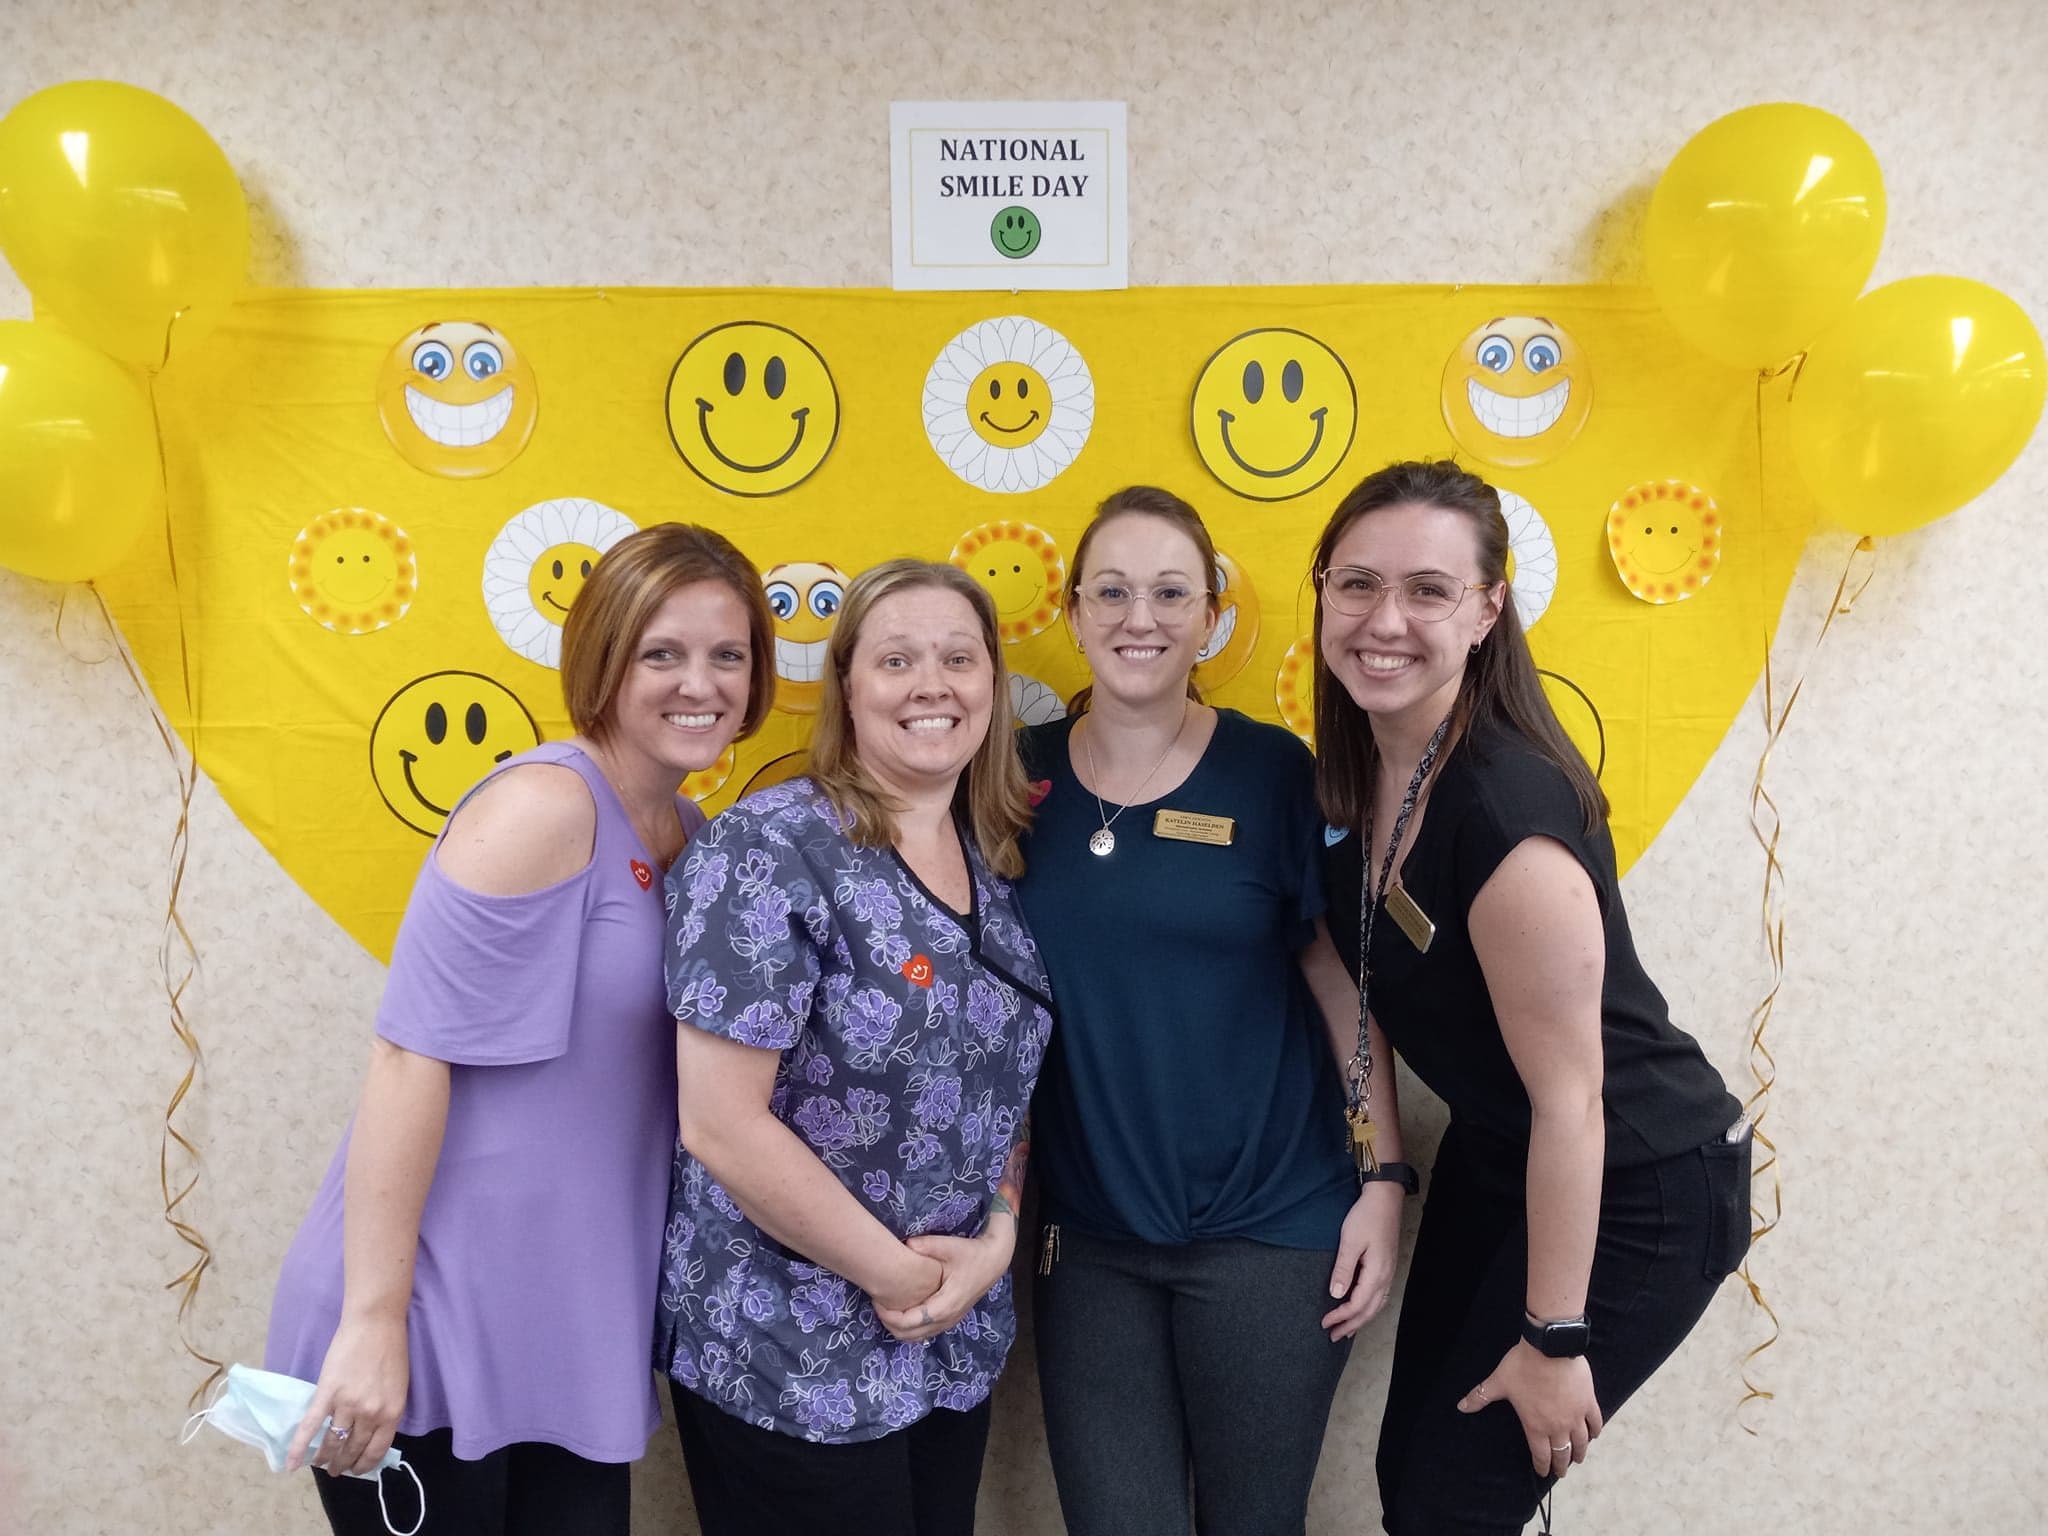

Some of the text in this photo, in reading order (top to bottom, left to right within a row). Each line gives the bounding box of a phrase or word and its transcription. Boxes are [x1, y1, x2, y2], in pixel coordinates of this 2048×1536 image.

[940, 138, 1085, 161] NATIONAL
[940, 175, 1089, 198] SMILE DAY
